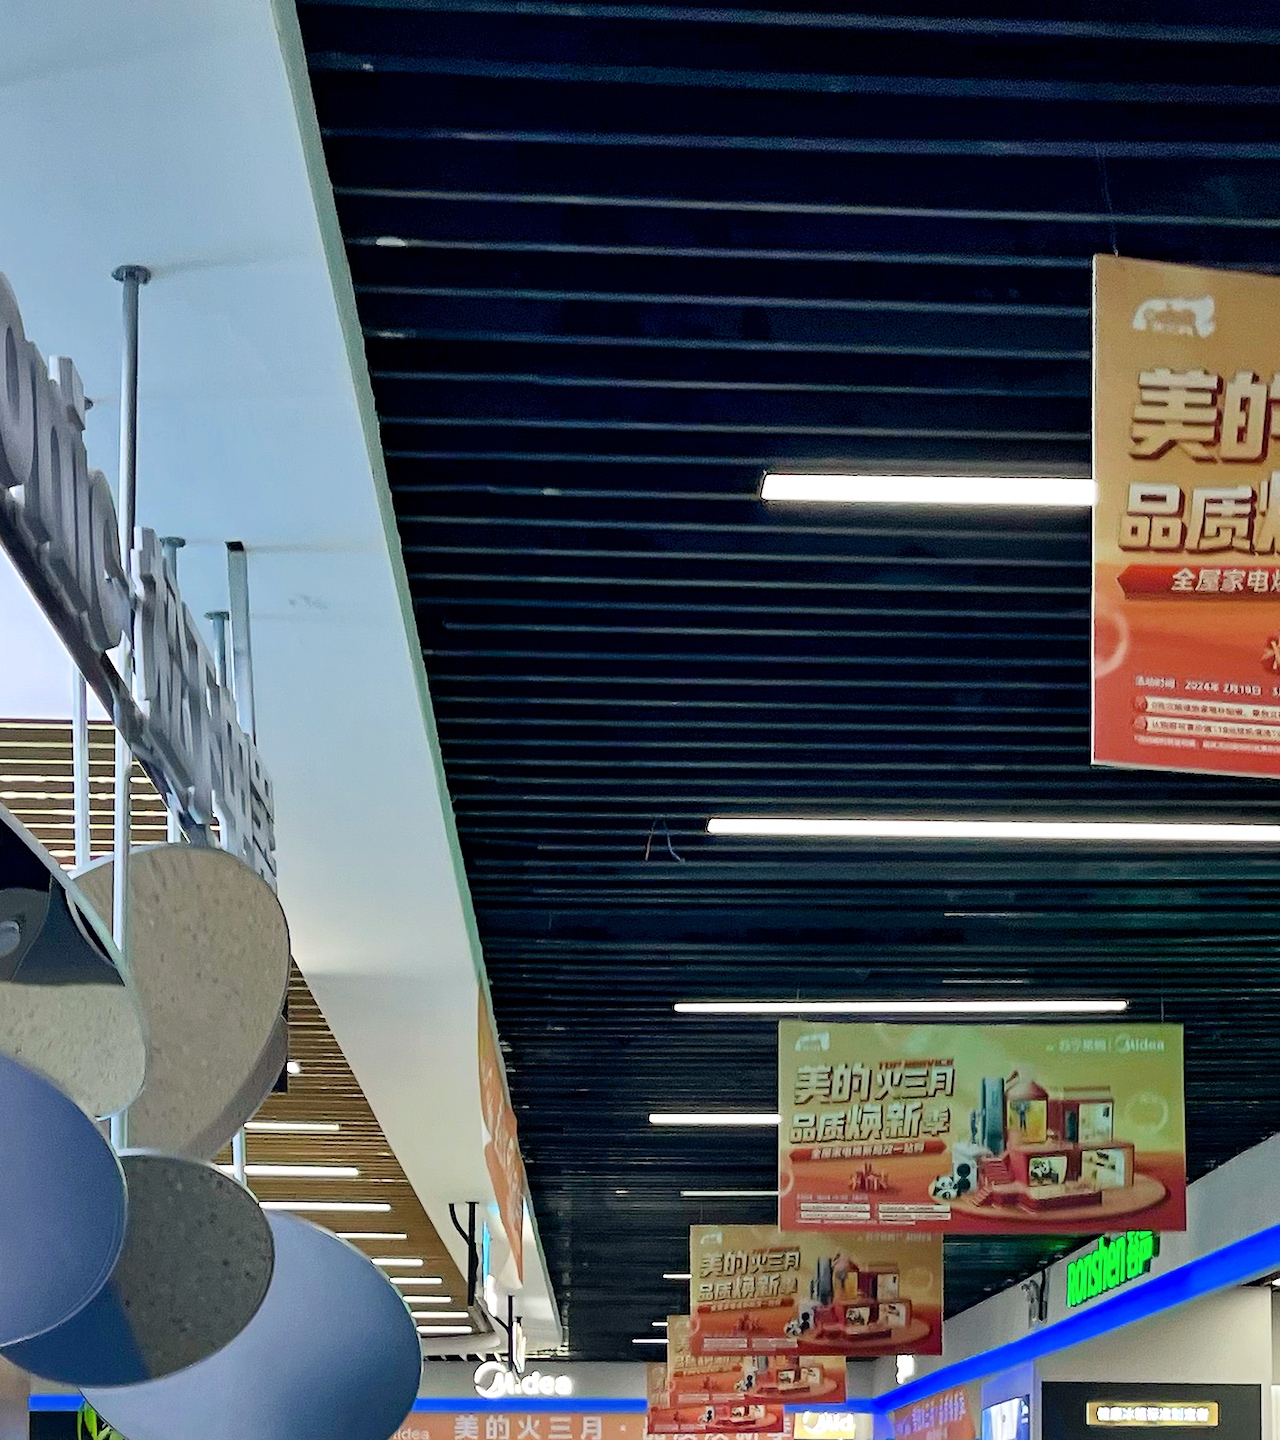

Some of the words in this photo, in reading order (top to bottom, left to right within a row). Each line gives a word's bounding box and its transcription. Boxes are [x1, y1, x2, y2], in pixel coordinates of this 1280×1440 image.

[794, 1062, 956, 1106] 美的火三月
[790, 1101, 951, 1144] 品质焕新季
[473, 1361, 575, 1399] Midea
[802, 1410, 854, 1436] Mid
